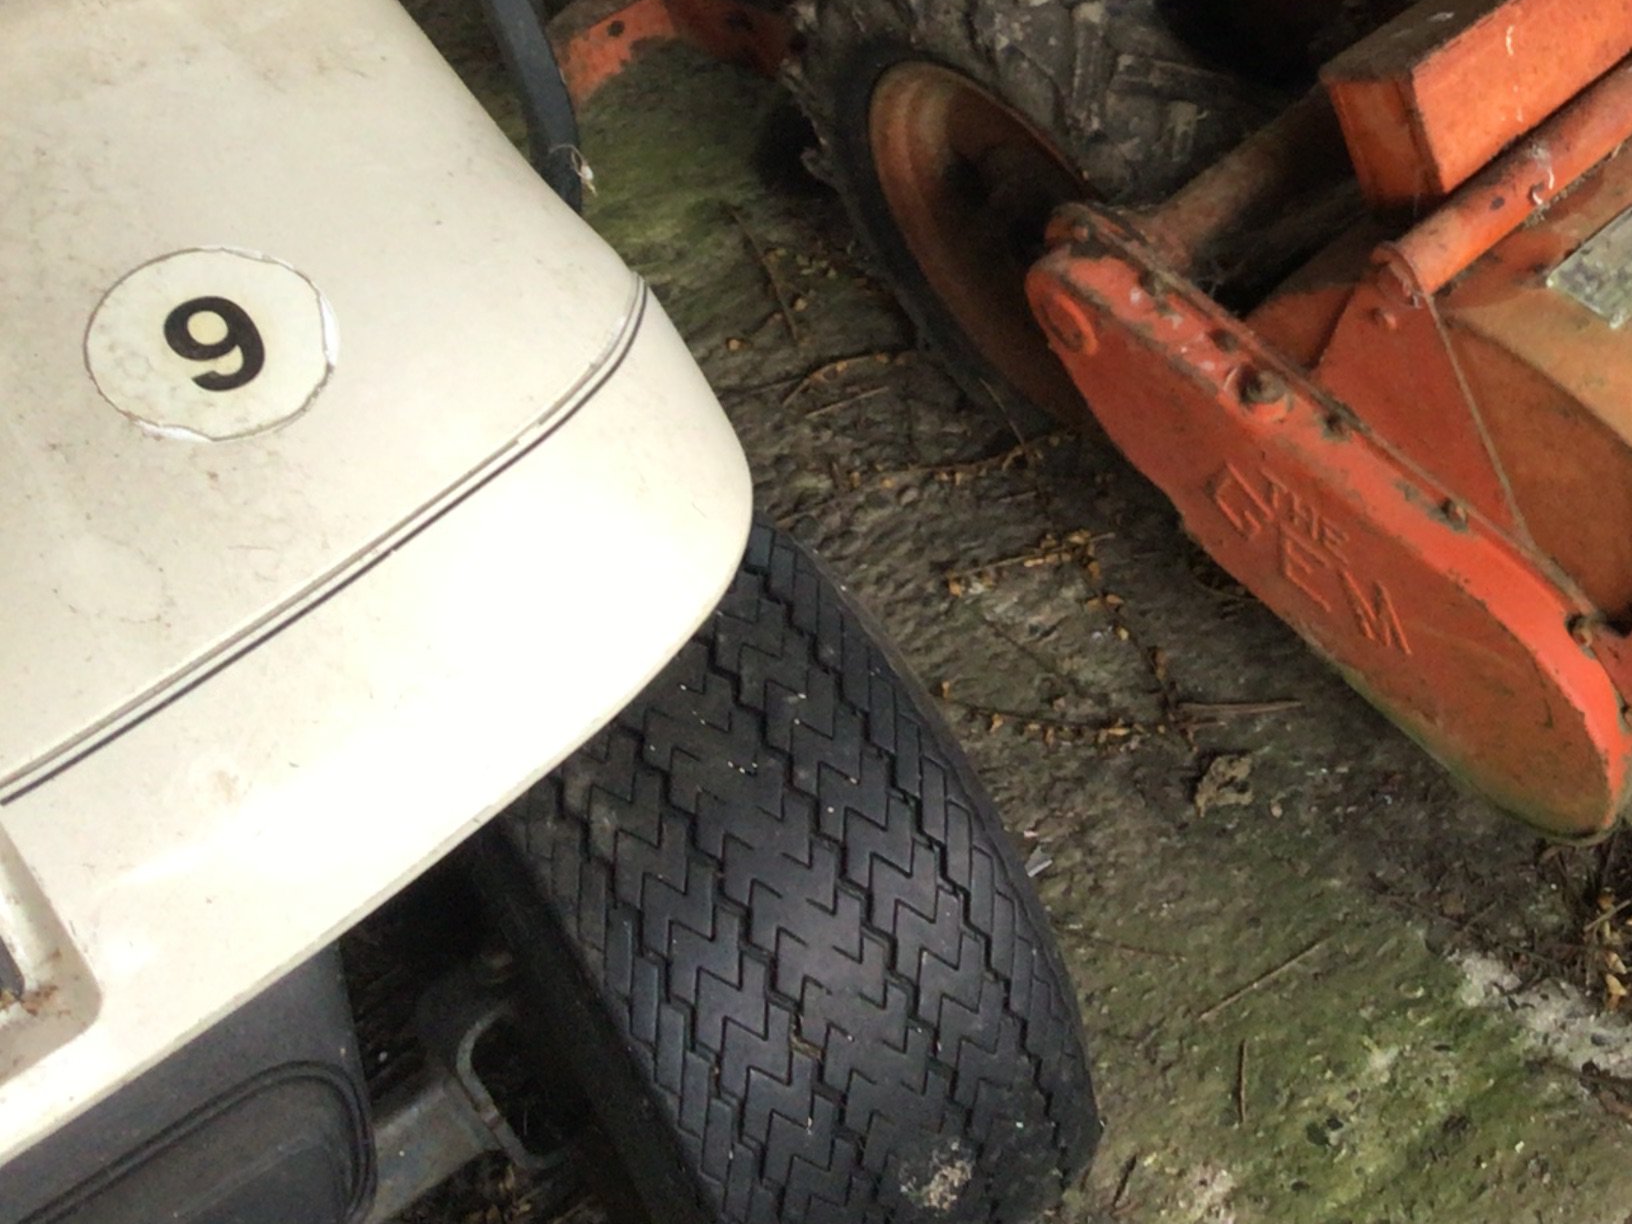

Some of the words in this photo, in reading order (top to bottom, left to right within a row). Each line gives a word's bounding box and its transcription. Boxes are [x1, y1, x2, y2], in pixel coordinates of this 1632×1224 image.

[163, 295, 265, 392] 9
[1213, 460, 1413, 657] GEM
[1260, 466, 1352, 567] THE
